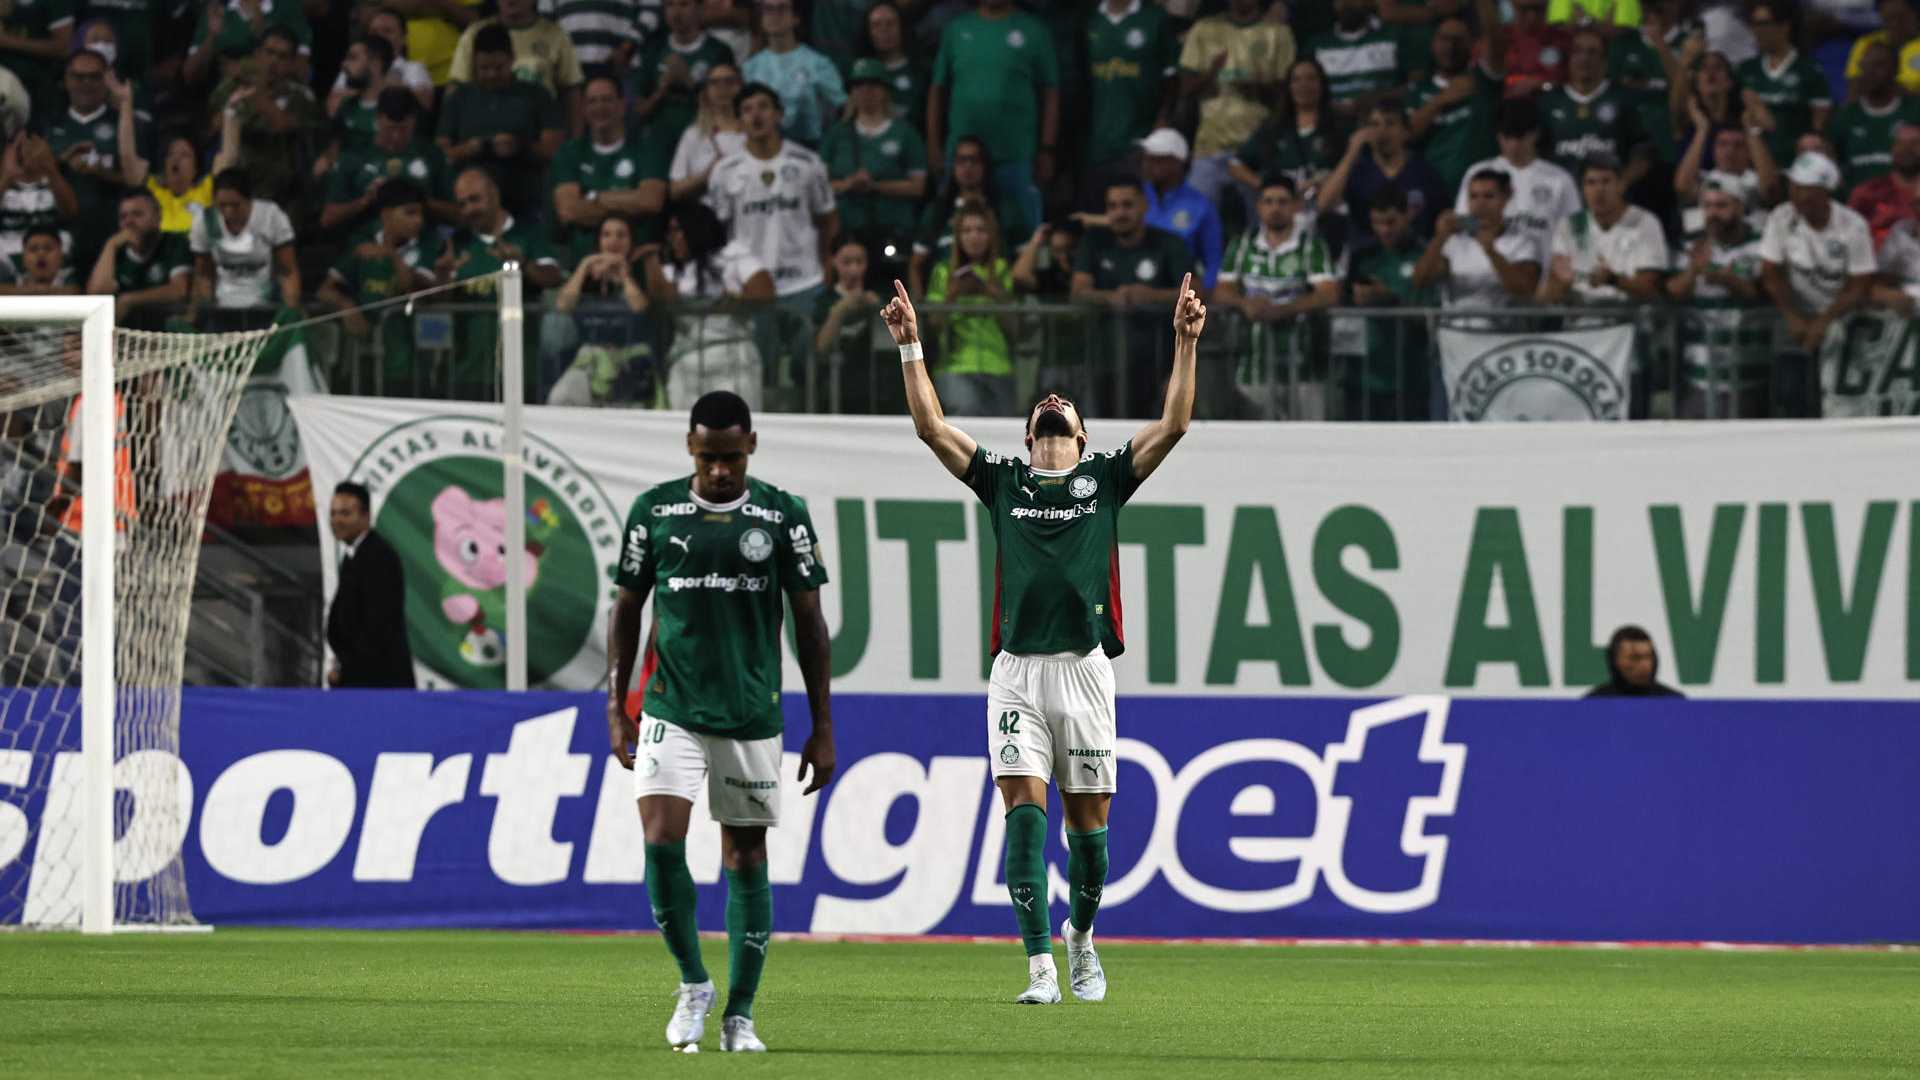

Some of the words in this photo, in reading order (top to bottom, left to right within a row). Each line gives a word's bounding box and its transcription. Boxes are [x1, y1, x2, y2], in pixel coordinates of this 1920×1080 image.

[651, 503, 697, 516] CIMED
[742, 504, 784, 523] CIMED
[1011, 500, 1098, 520] sportingbet
[668, 572, 769, 592] sportingbet
[998, 710, 1020, 735] 42
